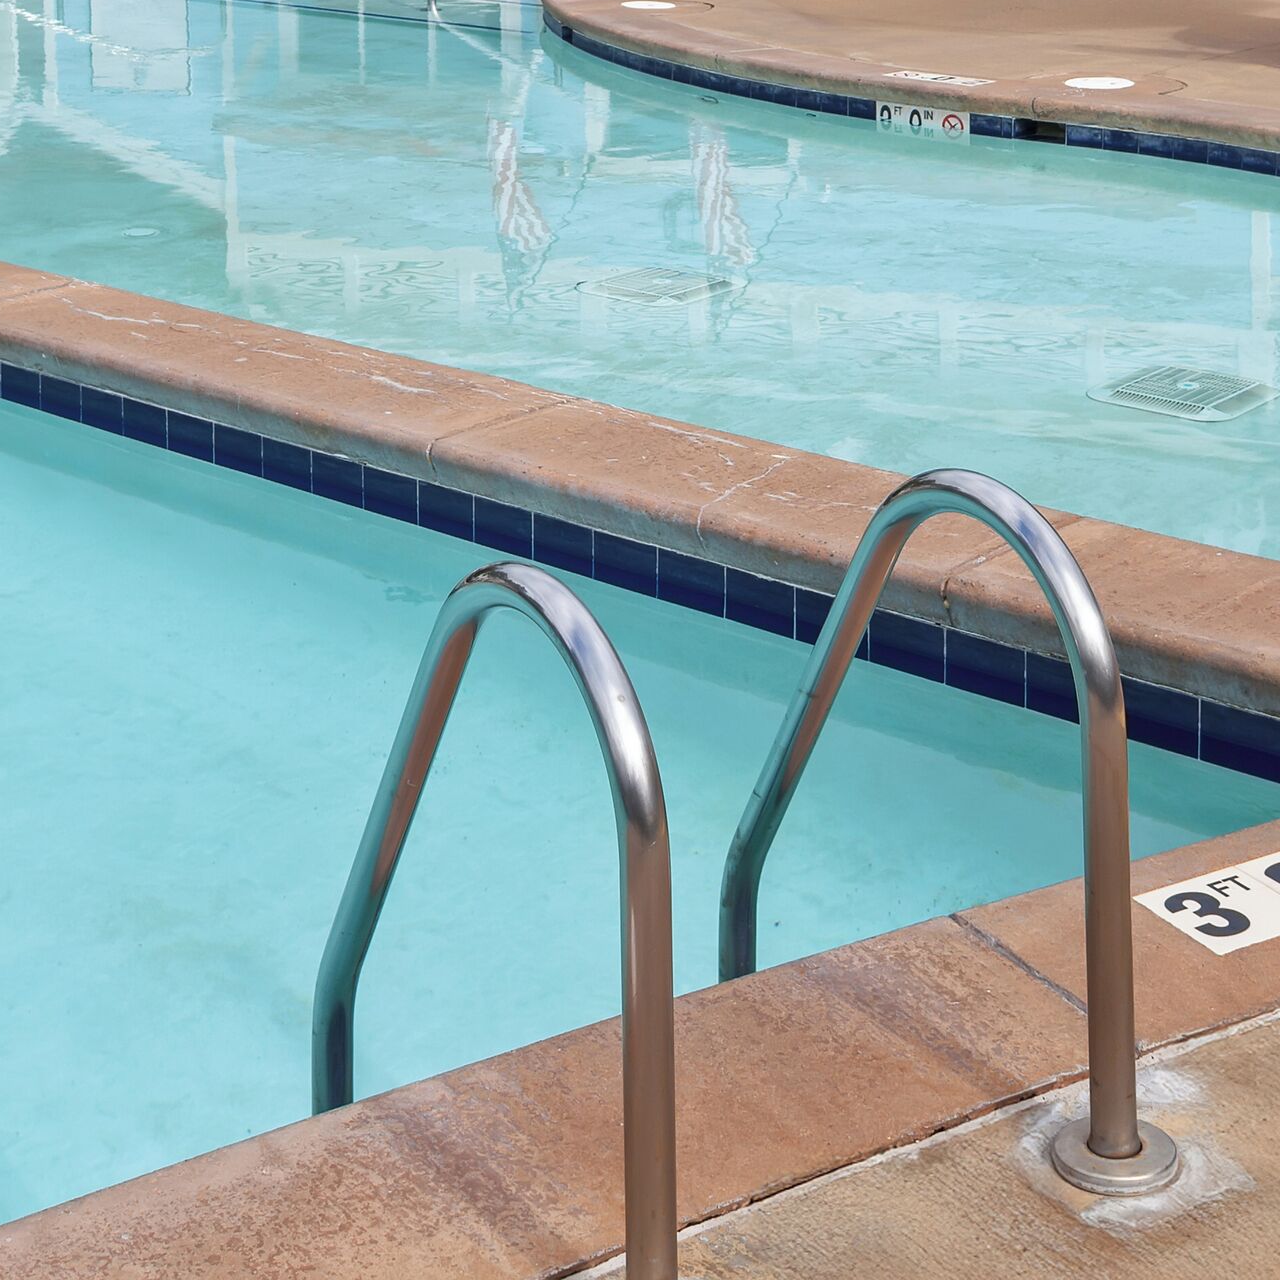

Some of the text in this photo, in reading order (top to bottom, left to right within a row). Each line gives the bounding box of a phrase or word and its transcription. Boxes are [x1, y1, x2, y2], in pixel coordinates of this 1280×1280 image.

[894, 106, 902, 116] FT
[923, 110, 934, 121] IN
[1206, 874, 1251, 898] FT
[1164, 891, 1251, 937] 3
